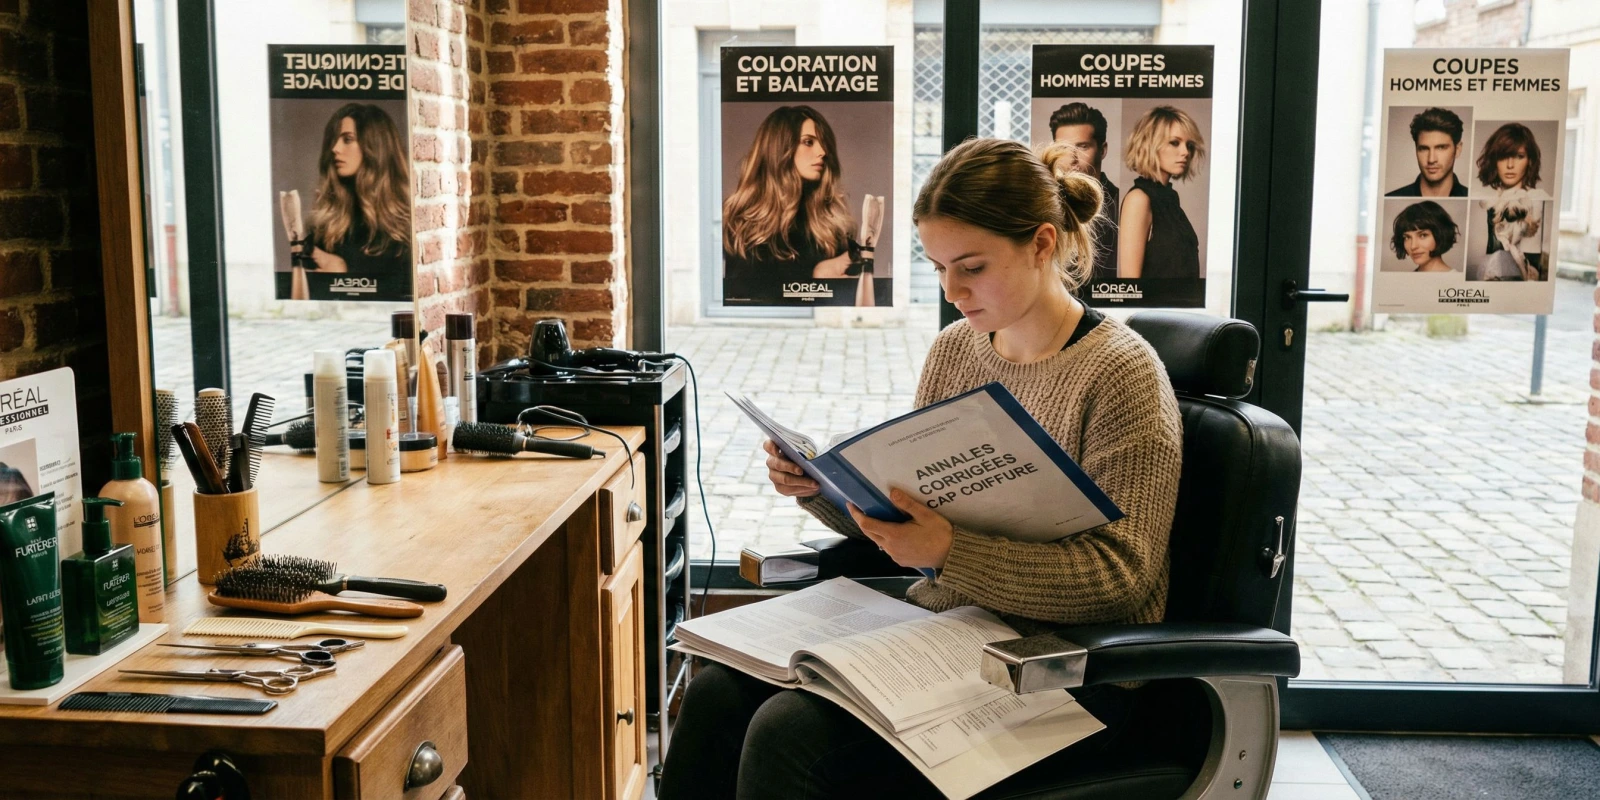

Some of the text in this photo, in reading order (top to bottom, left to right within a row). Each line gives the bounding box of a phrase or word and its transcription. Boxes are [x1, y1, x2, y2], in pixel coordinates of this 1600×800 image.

[737, 55, 877, 73] COLORATION
[1080, 53, 1166, 72] COUPES
[1432, 58, 1519, 75] COUPES
[736, 75, 879, 93] ET BALAYAGE
[1040, 74, 1204, 88] HOMMES ET FEMMES
[1390, 78, 1561, 92] HOMMES ET FEMMES
[1092, 283, 1143, 294] L'ORÉAL
[915, 443, 996, 480] ANNALES
[919, 453, 1017, 495] CORRIGÉES
[926, 462, 1039, 509] CAP COIFFURE
[15, 536, 58, 558] FURTERER
